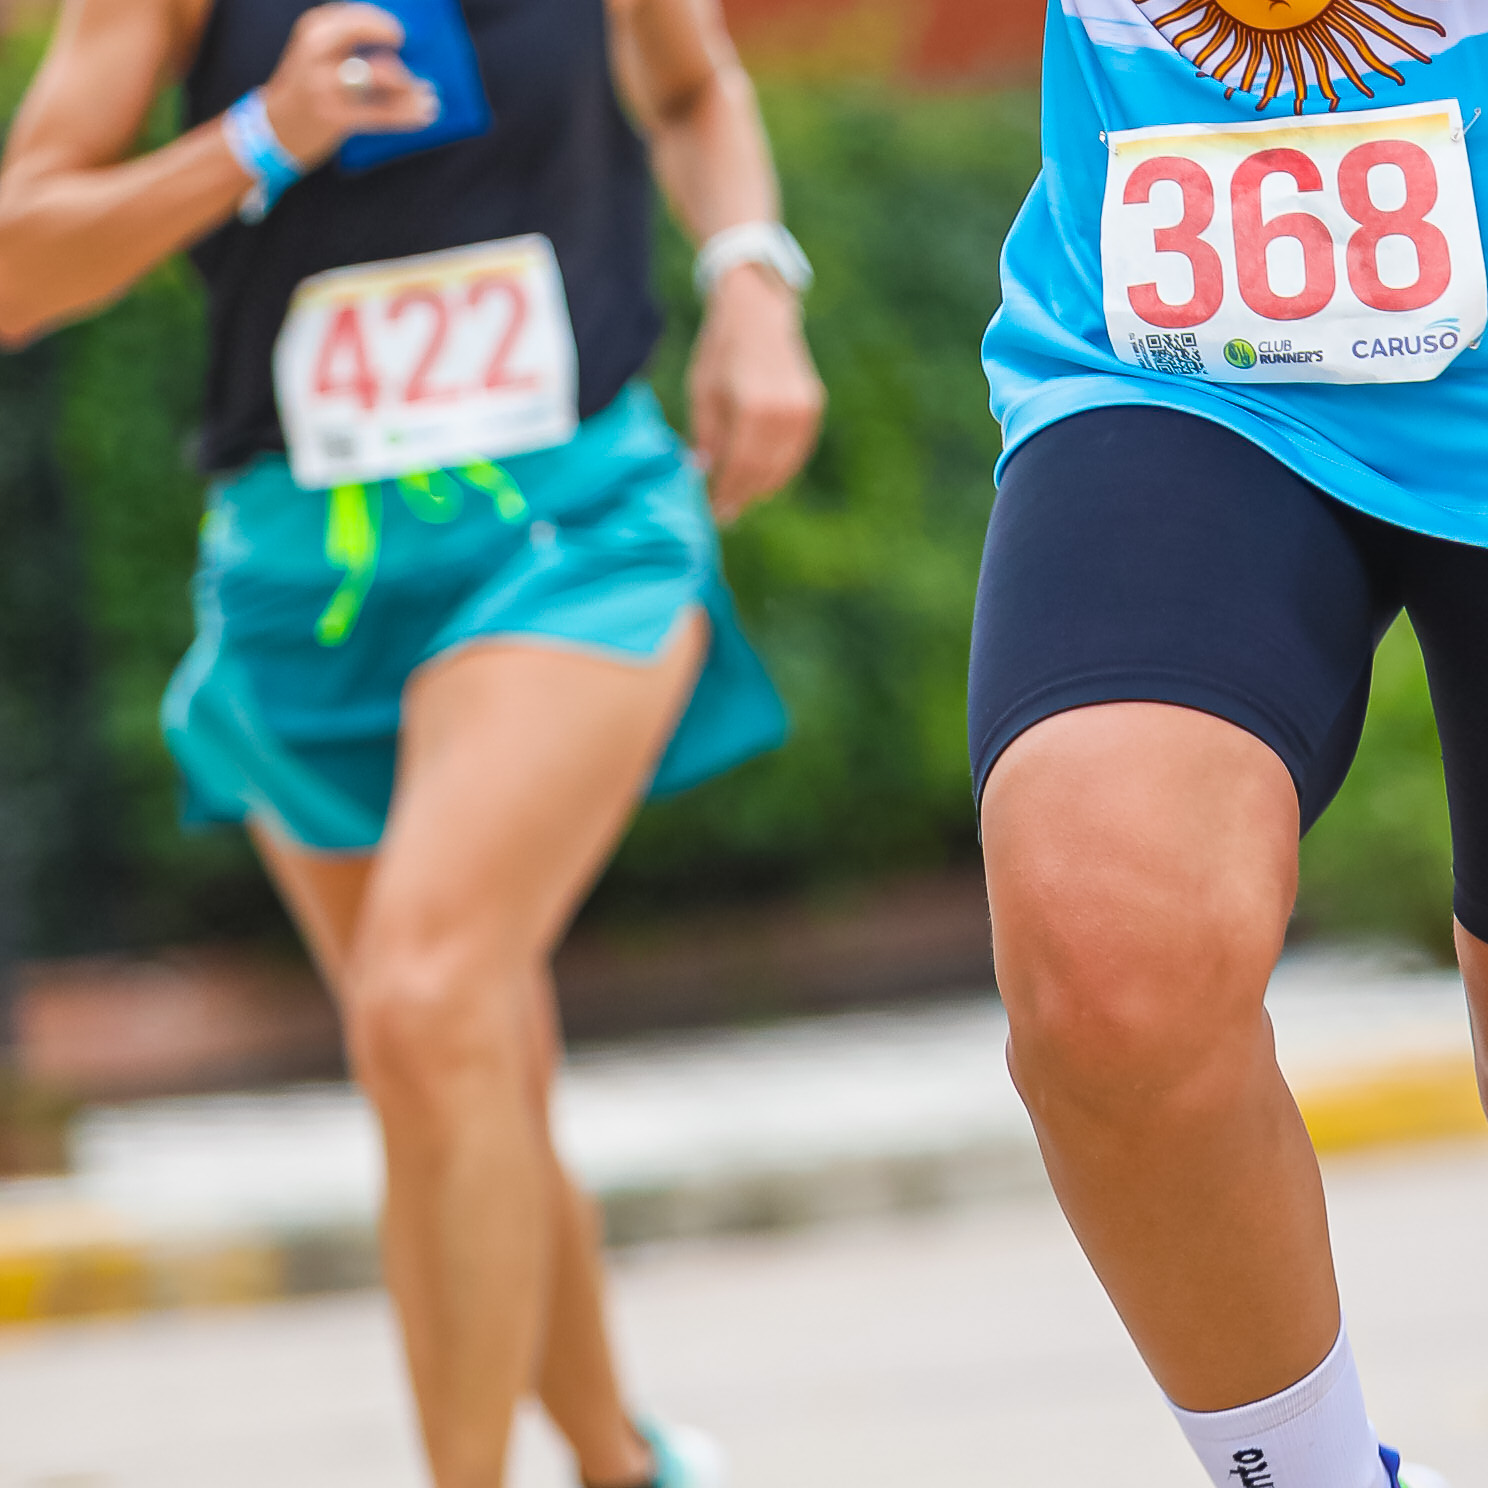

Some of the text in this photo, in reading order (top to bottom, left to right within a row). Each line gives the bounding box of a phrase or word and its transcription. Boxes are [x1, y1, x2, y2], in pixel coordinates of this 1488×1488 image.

[1122, 138, 1453, 330] 368
[311, 271, 541, 413] 422
[1258, 339, 1293, 354] CLUB
[1352, 331, 1459, 360] CARUSO
[1259, 350, 1324, 365] RUNNER'S
